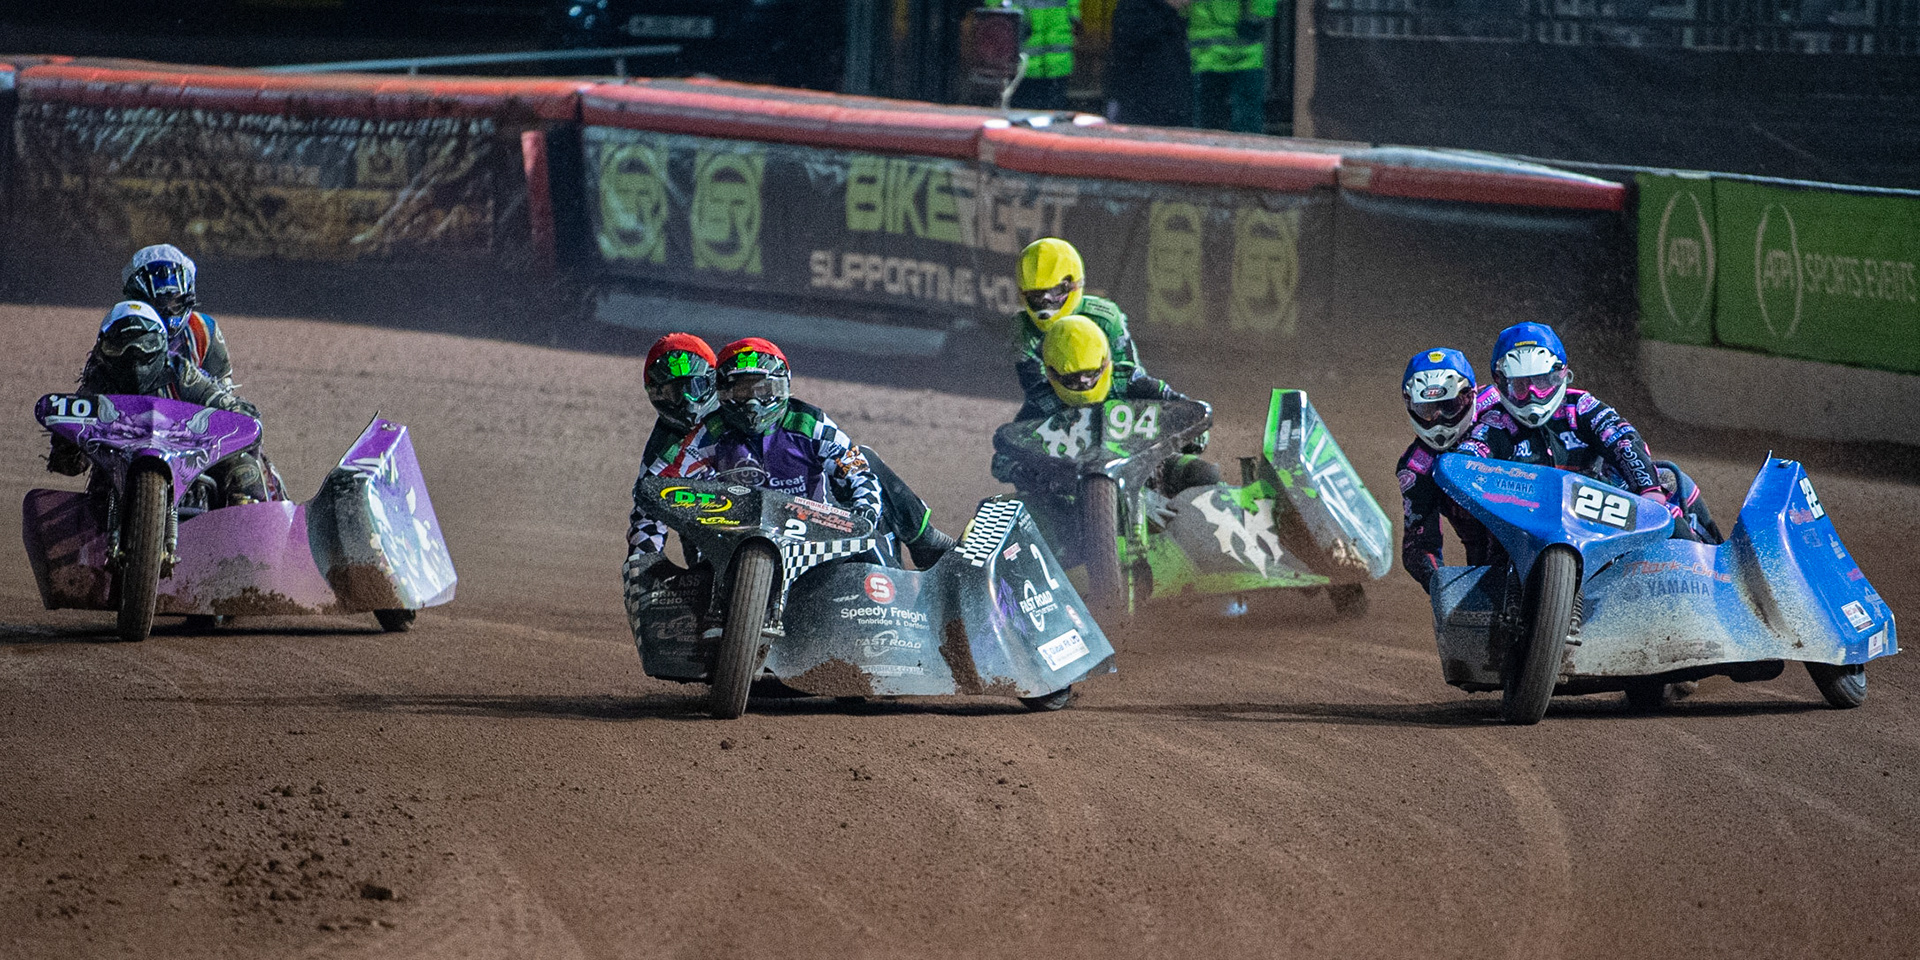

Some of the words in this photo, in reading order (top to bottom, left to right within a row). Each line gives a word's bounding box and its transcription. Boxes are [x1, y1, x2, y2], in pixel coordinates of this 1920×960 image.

[810, 250, 976, 306] SUPPORTING
[1804, 252, 1861, 298] SPORTS
[1864, 257, 1917, 303] EVENTS
[52, 397, 92, 417] 10
[1109, 404, 1158, 440] 94
[770, 475, 804, 487] Great
[1495, 479, 1536, 494] YAMAHA
[674, 490, 715, 506] DT
[1575, 485, 1631, 527] 22
[1799, 477, 1824, 519] 22
[784, 518, 807, 541] 2
[1030, 543, 1060, 591] 2
[1621, 560, 1733, 583] Mark-One
[1648, 579, 1711, 597] YAMAHA
[841, 605, 887, 620] Speedy
[891, 607, 928, 623] Freight
[858, 618, 893, 626] Tonbridge
[889, 638, 922, 649] ROAD
